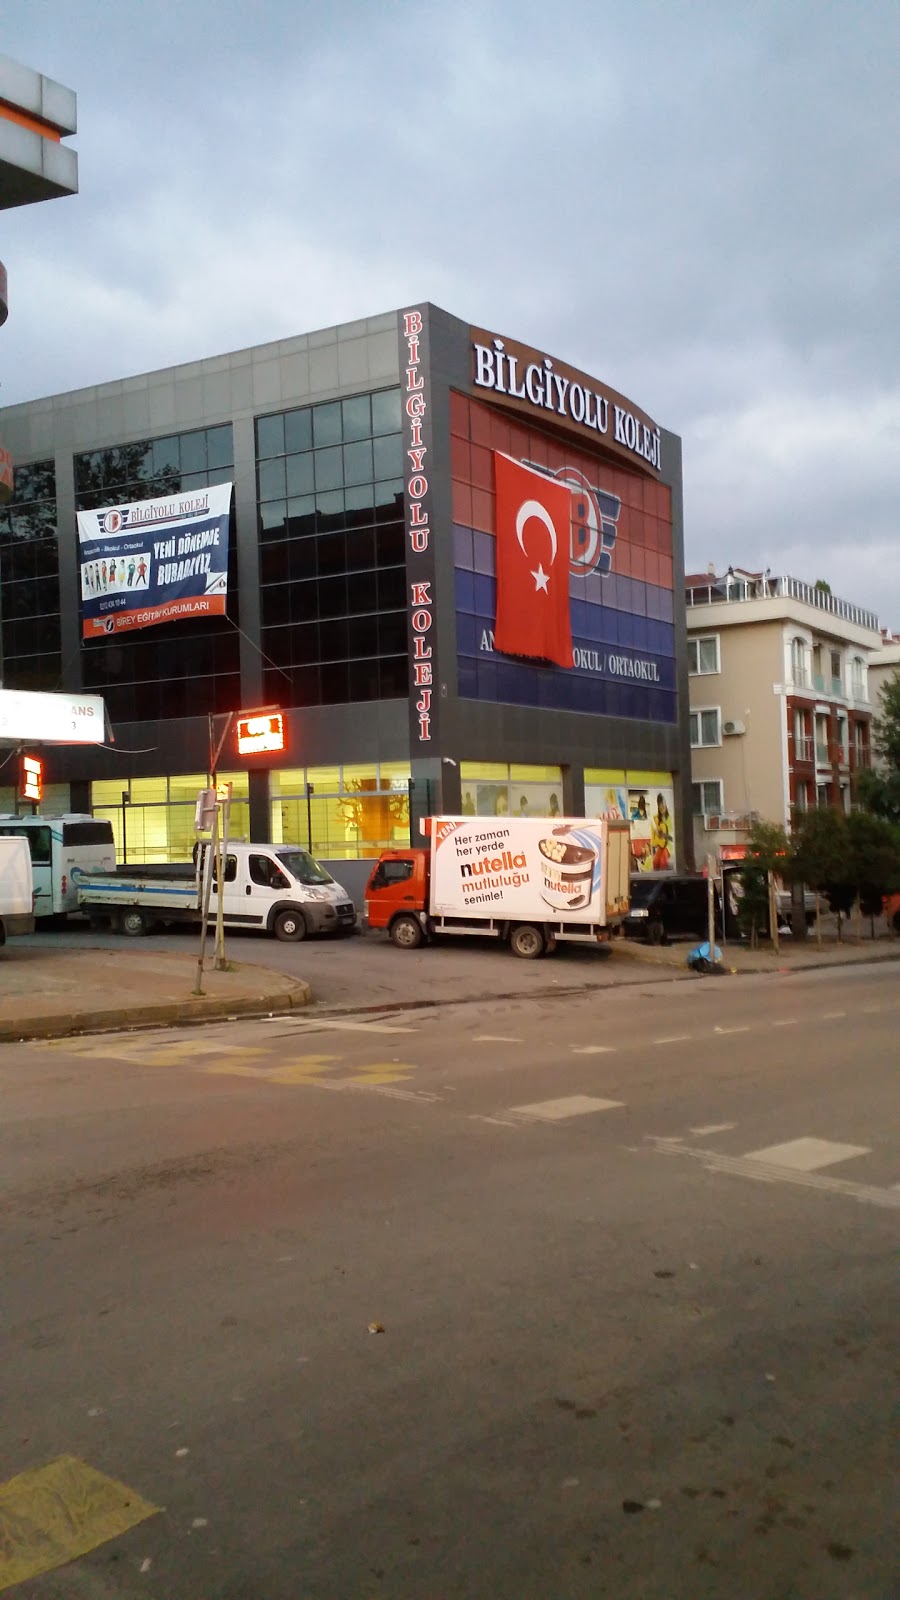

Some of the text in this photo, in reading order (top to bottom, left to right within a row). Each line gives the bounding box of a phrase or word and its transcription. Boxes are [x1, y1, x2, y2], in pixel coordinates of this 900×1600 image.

[474, 339, 662, 471] BİLGİYOLU KOLEJİ
[131, 504, 175, 522] BİLGİYOLU
[178, 494, 209, 513] KOLEJİ
[403, 311, 433, 740] BİLGİYOLU KOLEJİ
[153, 536, 176, 559] YENİ
[162, 601, 209, 617] KURUMLARI
[608, 655, 660, 682] ORTAOKUL
[454, 829, 510, 846] Her zaman
[456, 841, 505, 857] her yerde
[460, 851, 527, 878] nutella
[462, 872, 530, 893] mutluluğu
[544, 877, 582, 894] nutella
[464, 890, 504, 905] seninle!
